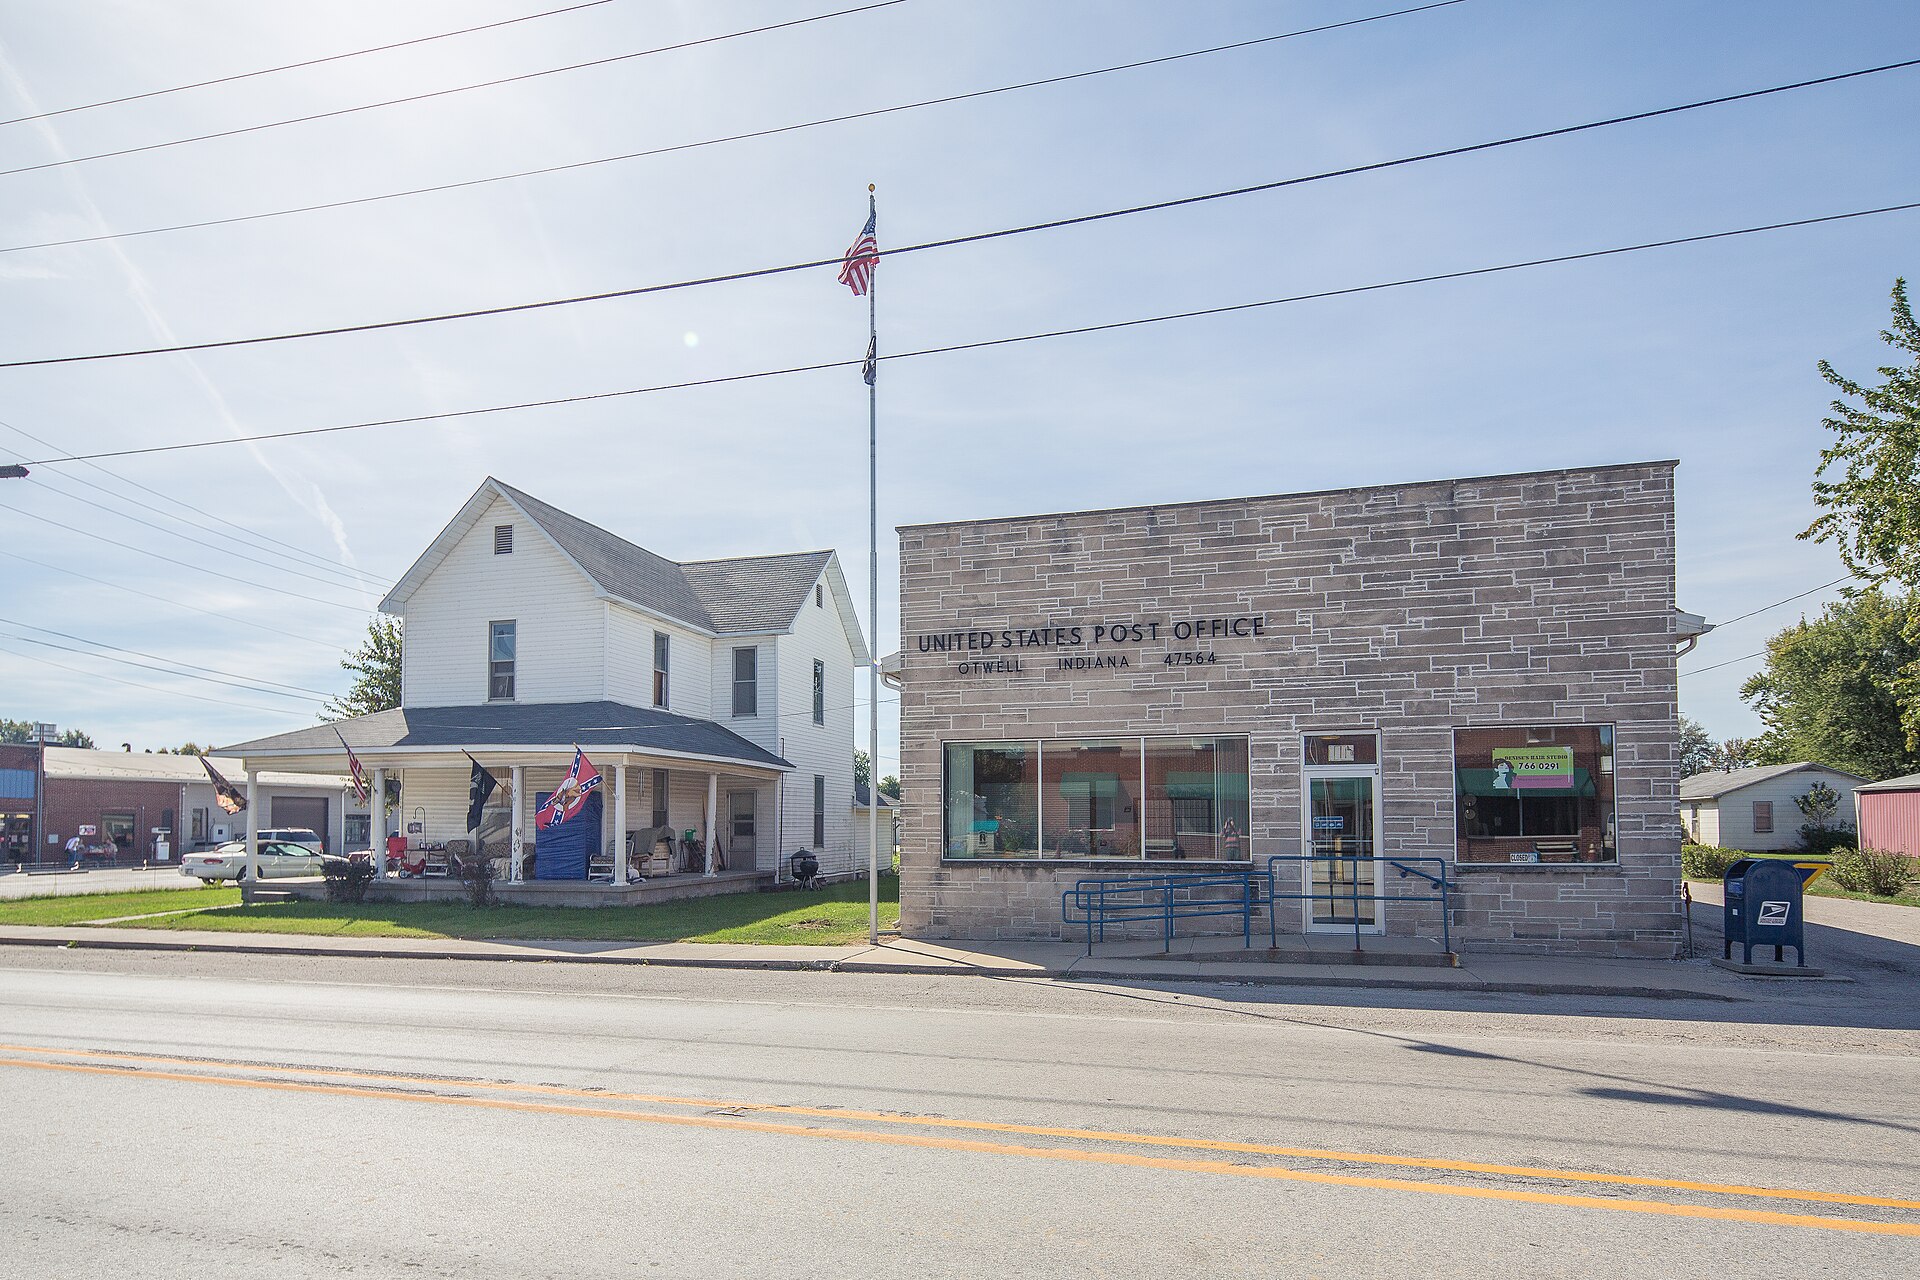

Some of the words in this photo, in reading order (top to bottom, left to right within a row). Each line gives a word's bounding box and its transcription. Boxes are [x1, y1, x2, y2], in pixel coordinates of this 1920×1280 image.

[919, 631, 994, 652] UNITED
[1001, 627, 1082, 649] STATES
[1094, 622, 1160, 643] POST
[1174, 616, 1265, 640] OFFICE
[958, 660, 1022, 675] OTWELL
[1058, 655, 1130, 671] INDIANA
[1164, 651, 1217, 666] 47564
[1518, 762, 1536, 770] 766
[1538, 762, 1559, 770] 0291
[1510, 854, 1528, 862] CLOSED
